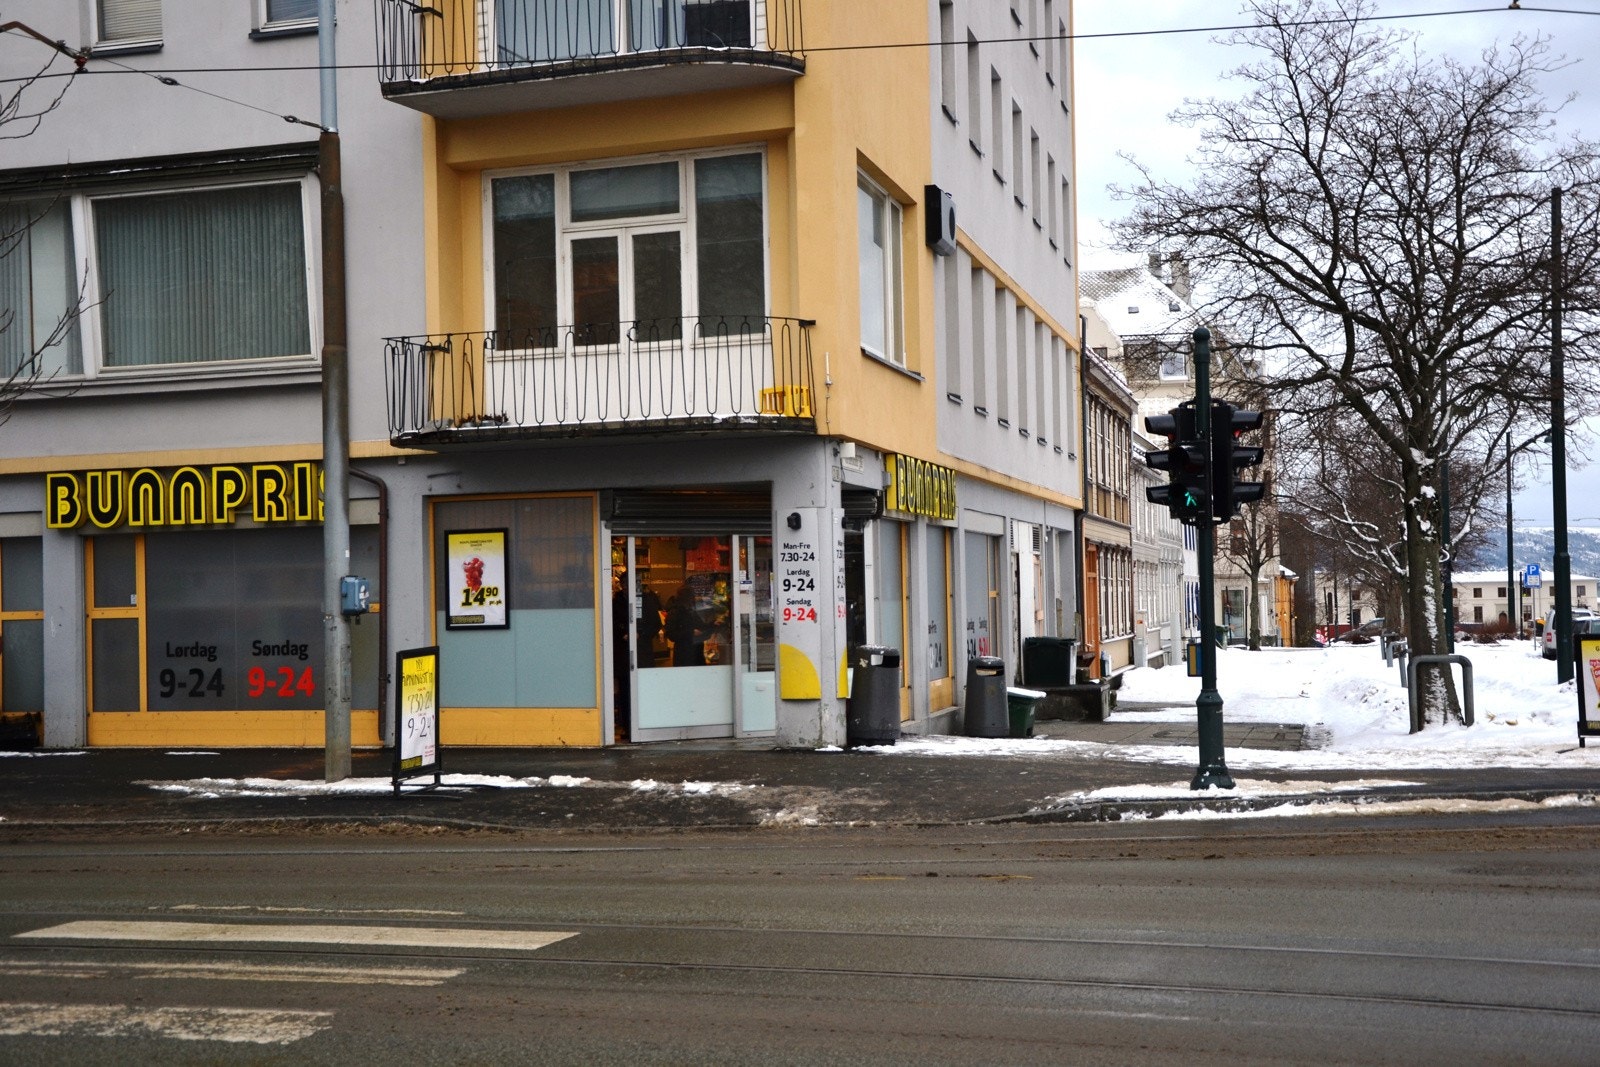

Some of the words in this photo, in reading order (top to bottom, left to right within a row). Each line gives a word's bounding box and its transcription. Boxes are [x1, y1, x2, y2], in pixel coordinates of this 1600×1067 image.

[46, 462, 326, 529] BUNNPRI
[780, 552, 815, 562] 7.30-24
[787, 569, 811, 577] Lørdag
[1529, 565, 1537, 575] P
[783, 578, 815, 592] 9-24
[786, 598, 812, 606] Søndag
[783, 607, 816, 621] 9-24
[166, 641, 218, 662] Lørdag
[252, 640, 309, 660] Søndag
[159, 667, 225, 698] 9-24
[247, 665, 316, 698] 9-24
